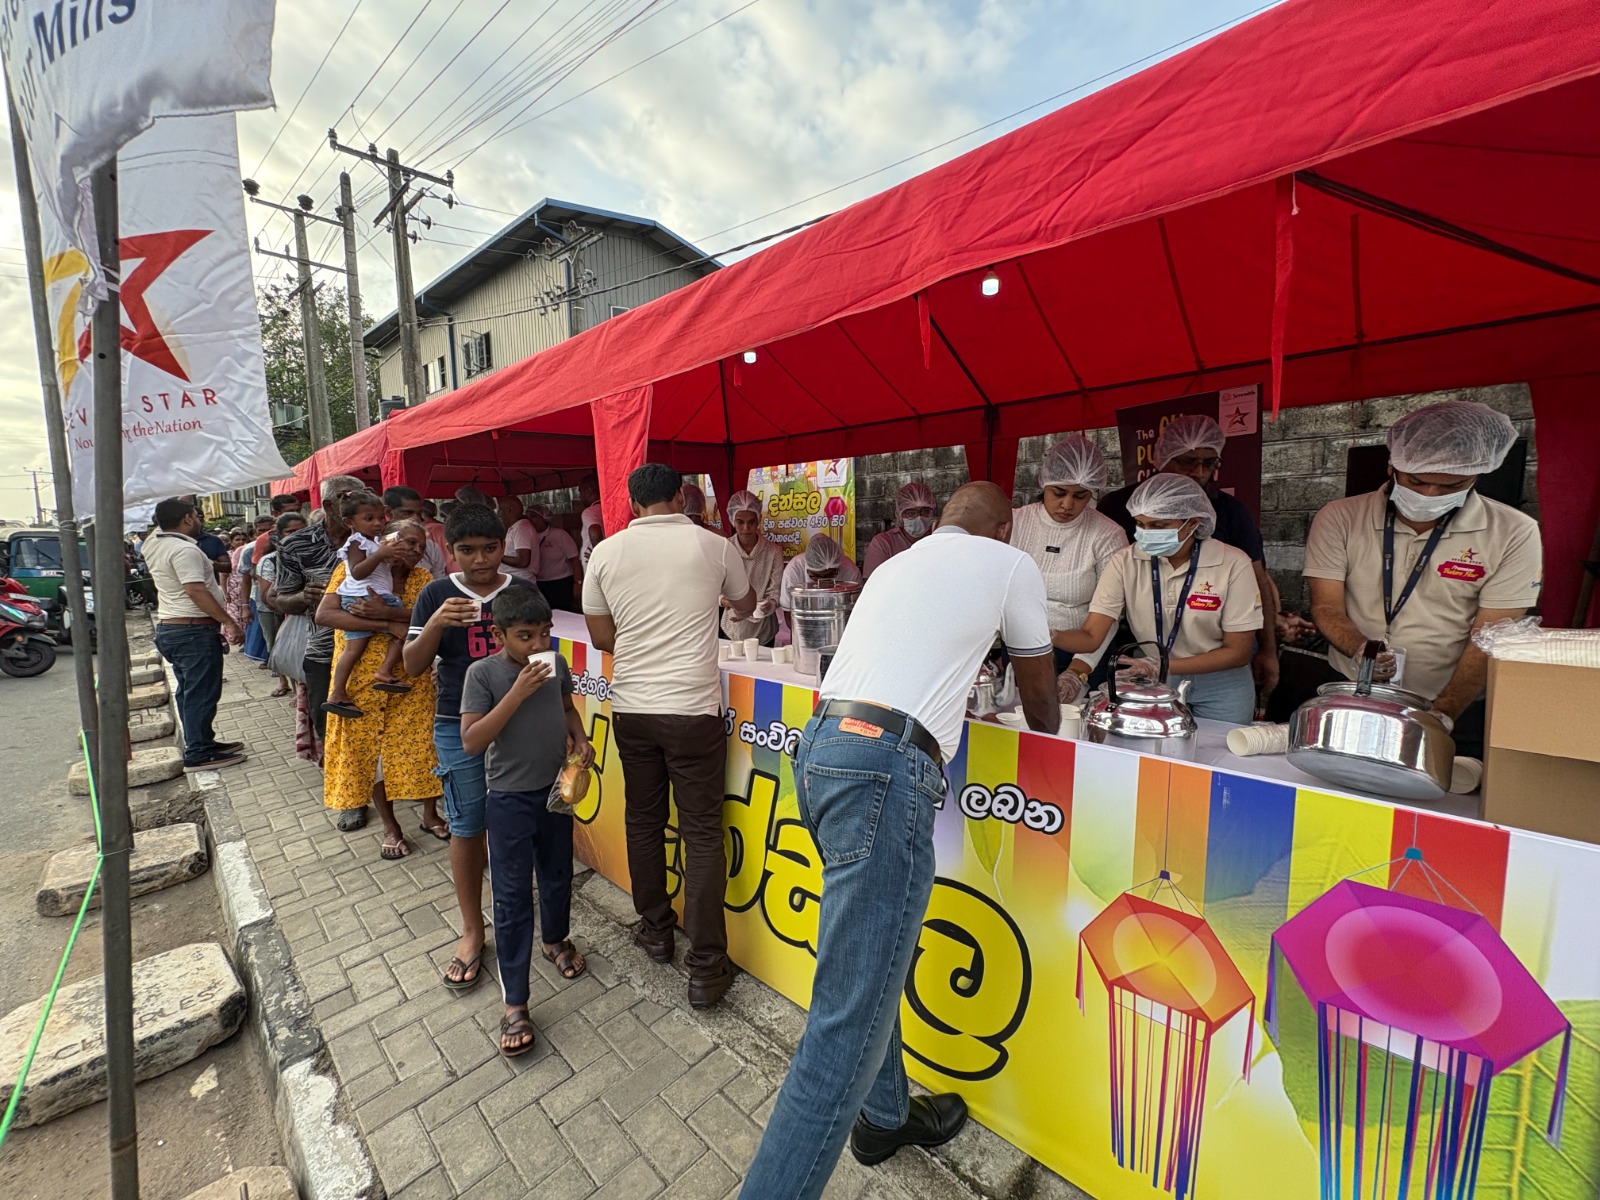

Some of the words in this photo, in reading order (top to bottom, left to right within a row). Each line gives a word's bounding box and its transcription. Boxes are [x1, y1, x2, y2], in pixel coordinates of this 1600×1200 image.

[33, 0, 137, 74] Mills
[141, 388, 218, 413] STAR
[1135, 429, 1155, 440] The
[768, 488, 822, 517] දන්සල
[960, 783, 1065, 835] ලබන
